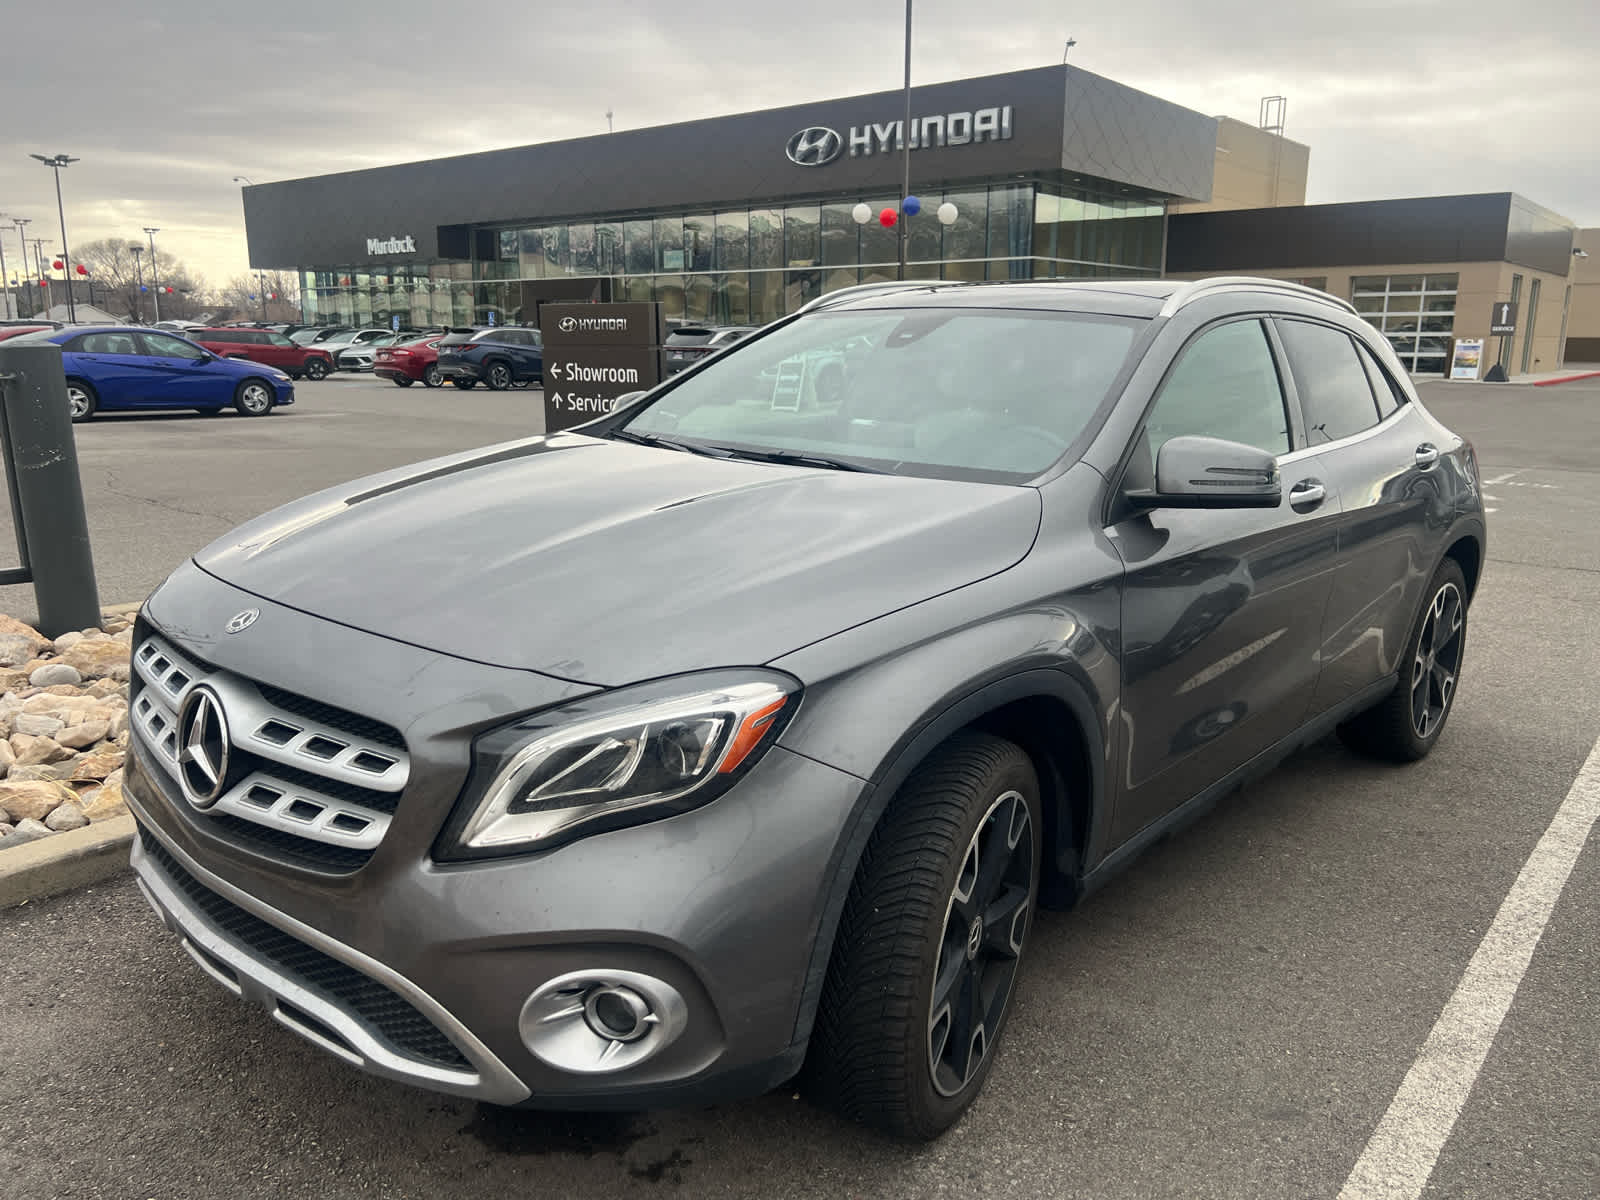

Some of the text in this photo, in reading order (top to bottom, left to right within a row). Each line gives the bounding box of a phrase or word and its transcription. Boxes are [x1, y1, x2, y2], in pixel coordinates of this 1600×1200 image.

[849, 105, 1013, 157] HYUNDAI
[366, 235, 416, 256] Murdock
[579, 318, 627, 331] HYUNDAI
[566, 362, 638, 384] Showroom
